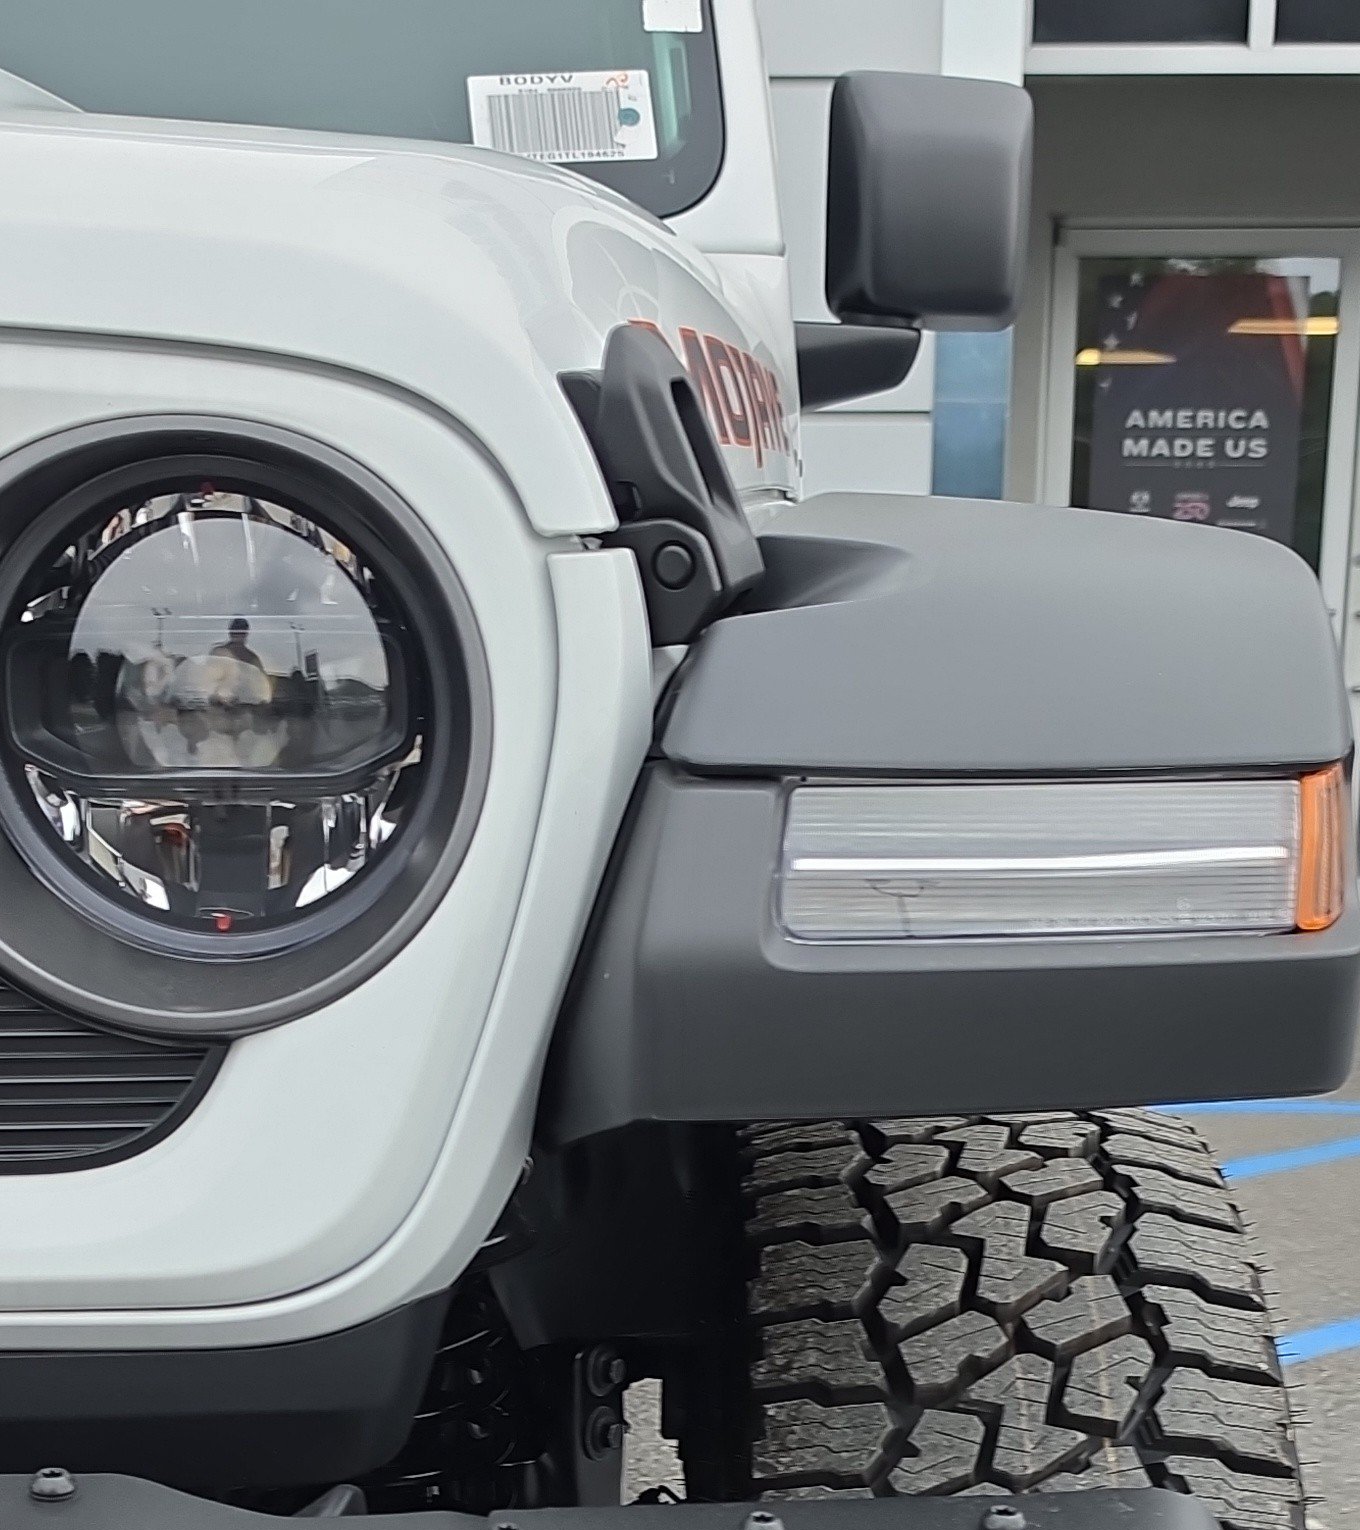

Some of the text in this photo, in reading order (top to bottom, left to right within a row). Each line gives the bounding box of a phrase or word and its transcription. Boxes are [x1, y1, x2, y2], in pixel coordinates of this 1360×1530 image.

[499, 75, 574, 86] BODYV
[1125, 409, 1269, 429] AMERICA
[1122, 437, 1269, 459] MADE US
